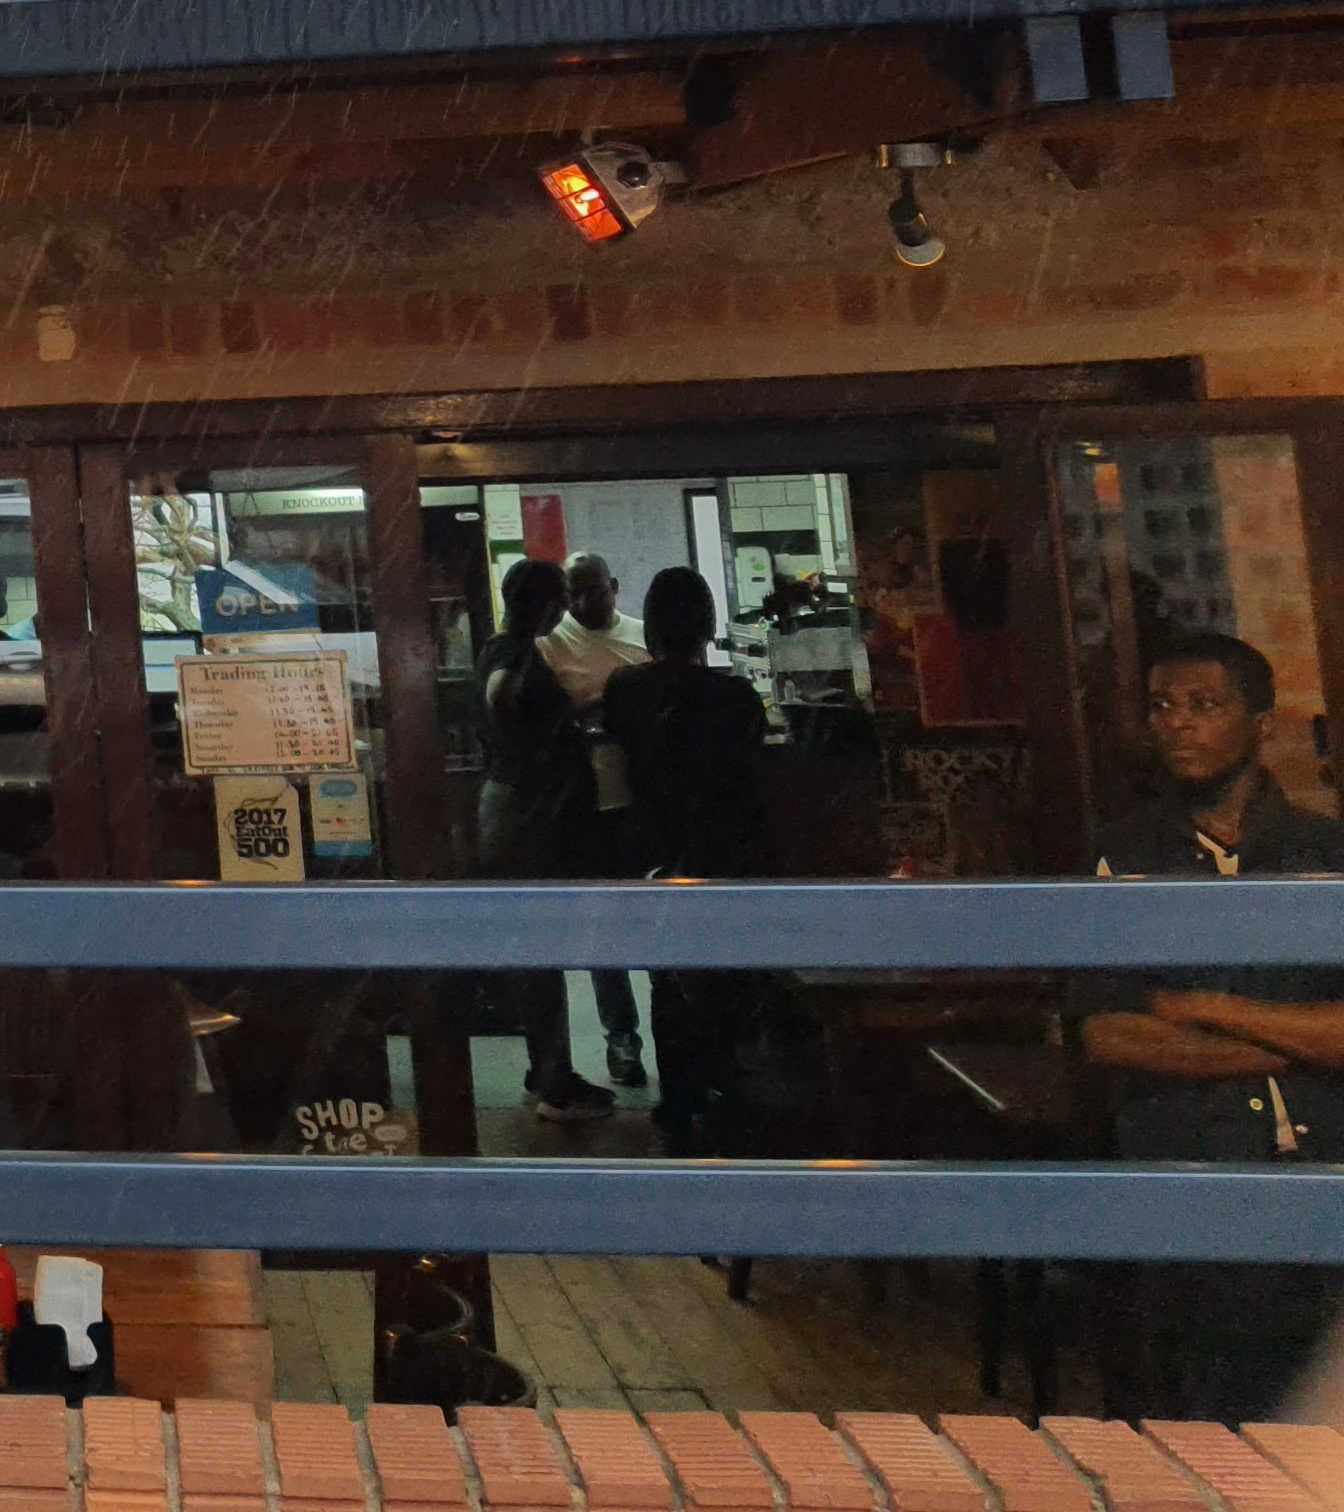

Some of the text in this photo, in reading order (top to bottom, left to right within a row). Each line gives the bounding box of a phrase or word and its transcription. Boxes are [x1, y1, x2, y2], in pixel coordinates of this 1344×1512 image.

[282, 495, 355, 510] KNOCKOUT
[199, 666, 267, 681] Trading
[234, 807, 287, 826] 2017
[236, 825, 289, 837] EatOut
[237, 837, 290, 858] 500
[295, 1098, 384, 1141] SHOP
